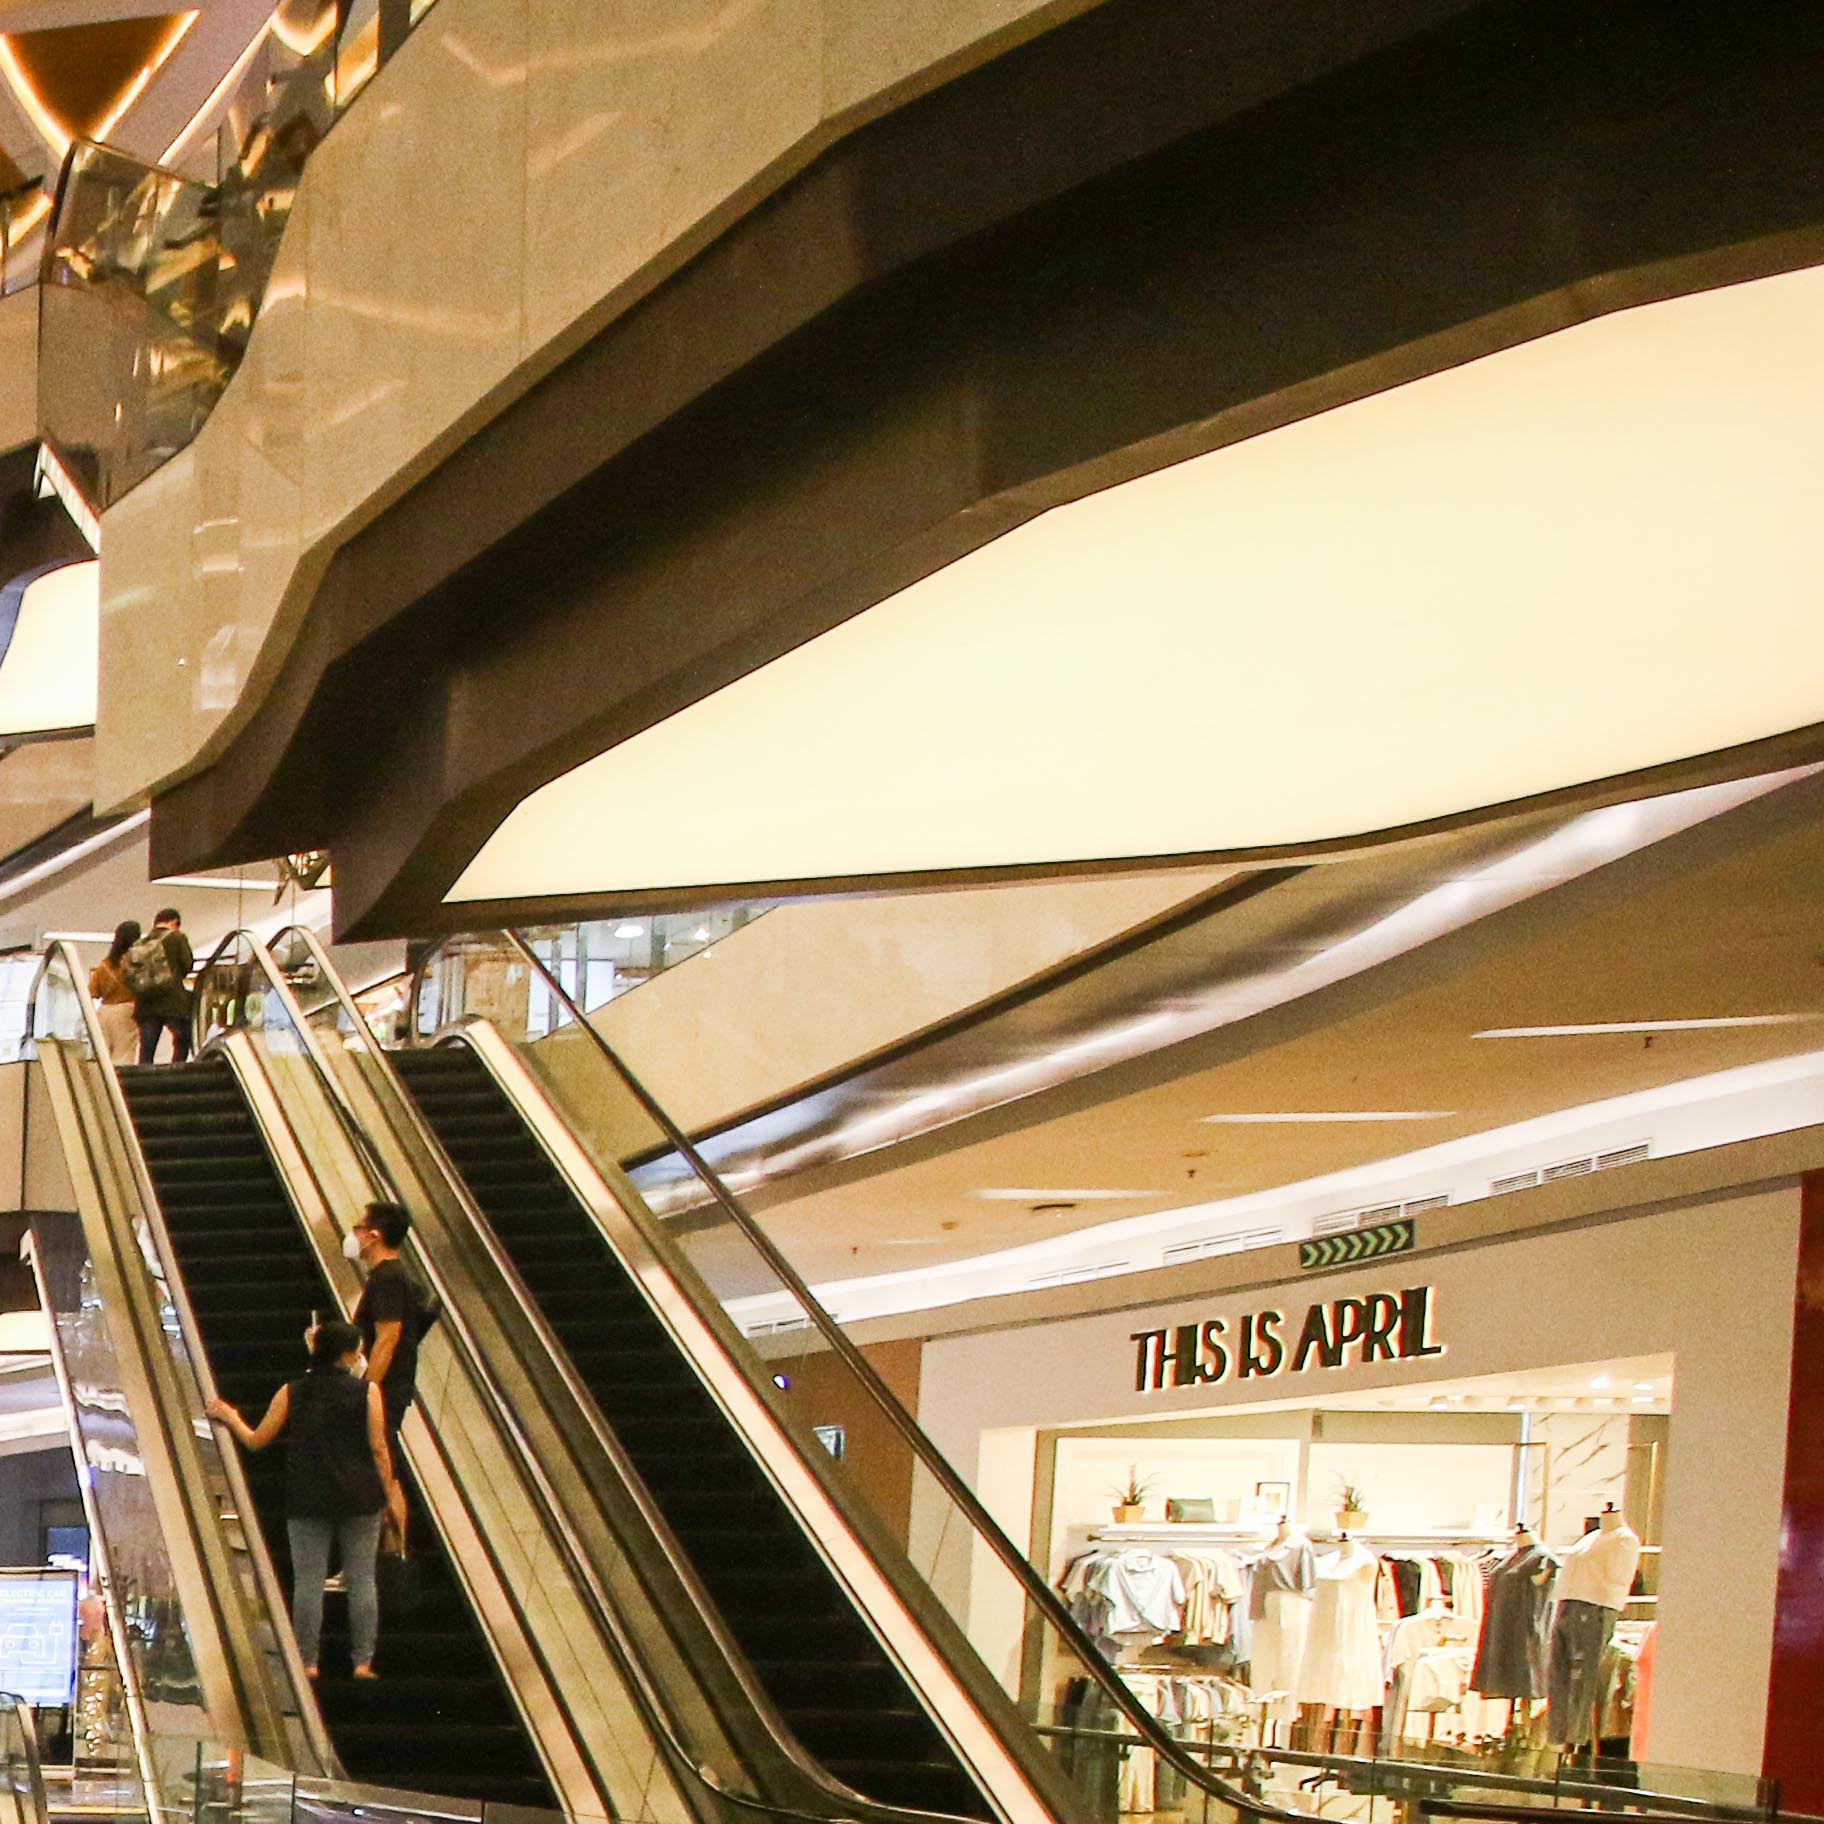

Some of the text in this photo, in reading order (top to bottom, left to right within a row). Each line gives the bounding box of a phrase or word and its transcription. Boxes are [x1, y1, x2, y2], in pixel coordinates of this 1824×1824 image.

[1131, 1285, 1443, 1393] THIS IS APRIL
